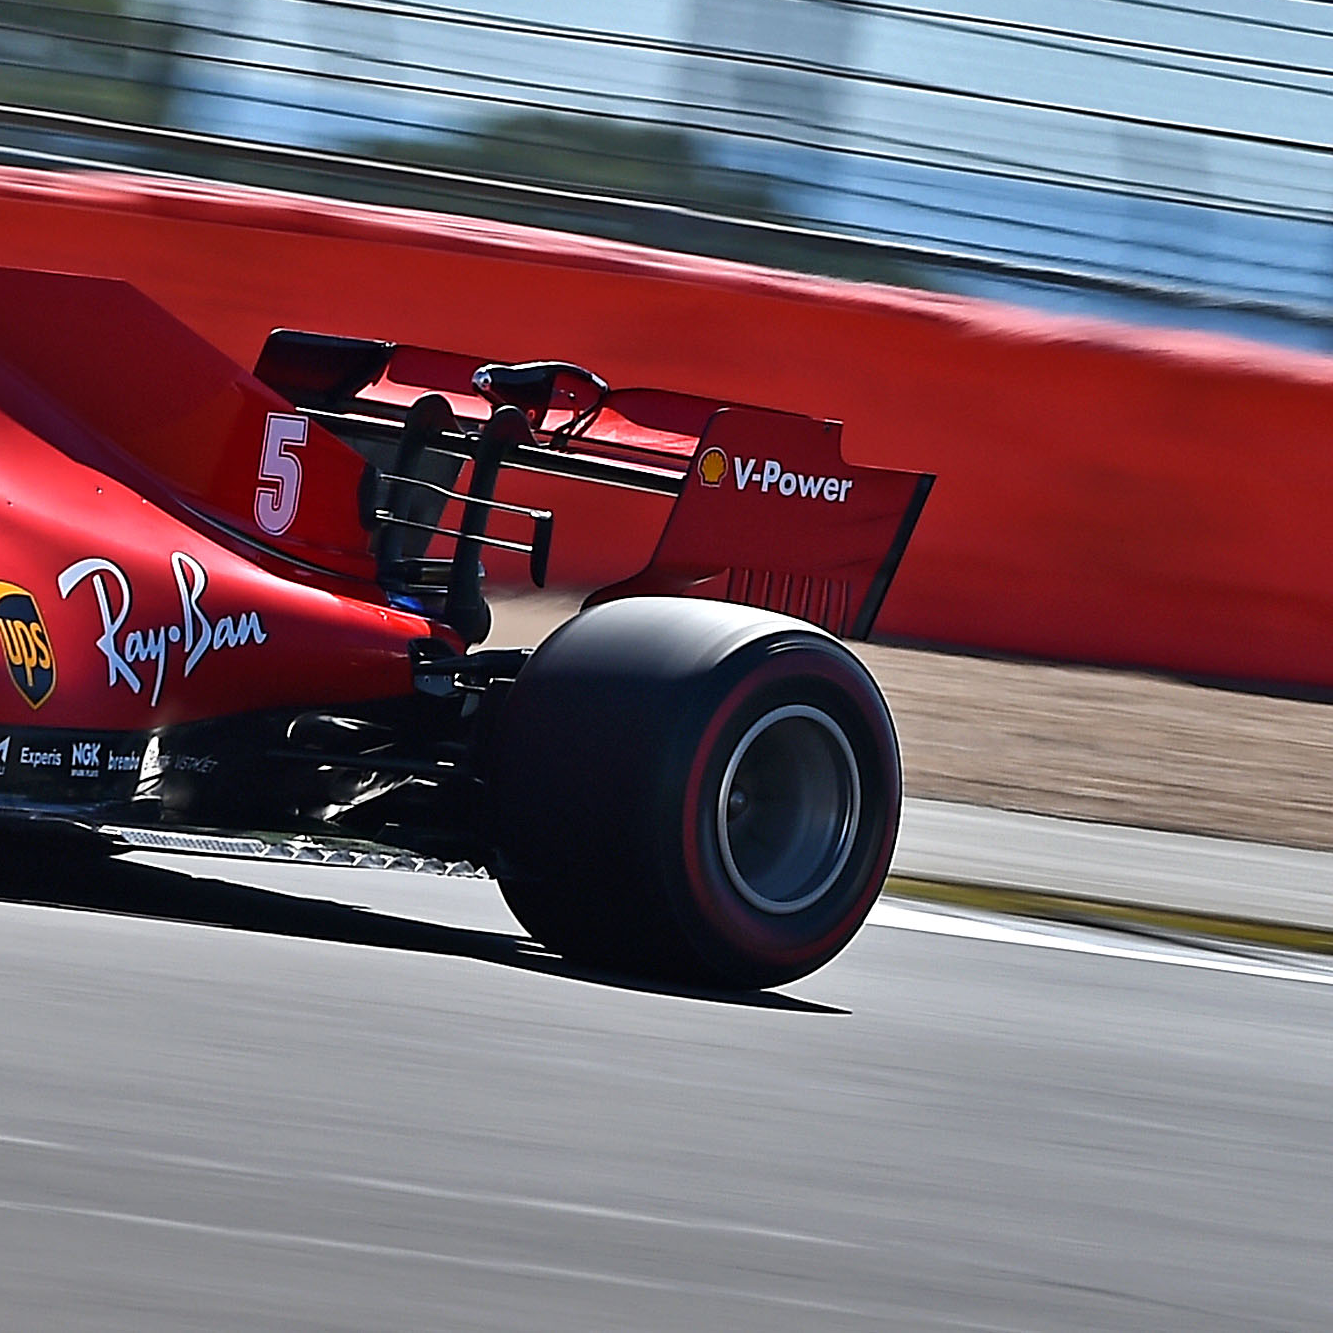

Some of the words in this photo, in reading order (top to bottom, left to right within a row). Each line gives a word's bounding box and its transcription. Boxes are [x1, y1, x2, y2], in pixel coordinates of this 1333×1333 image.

[254, 412, 309, 536] 5
[734, 457, 853, 502] V-Power
[20, 746, 62, 768] Experis
[71, 742, 102, 767] NGK
